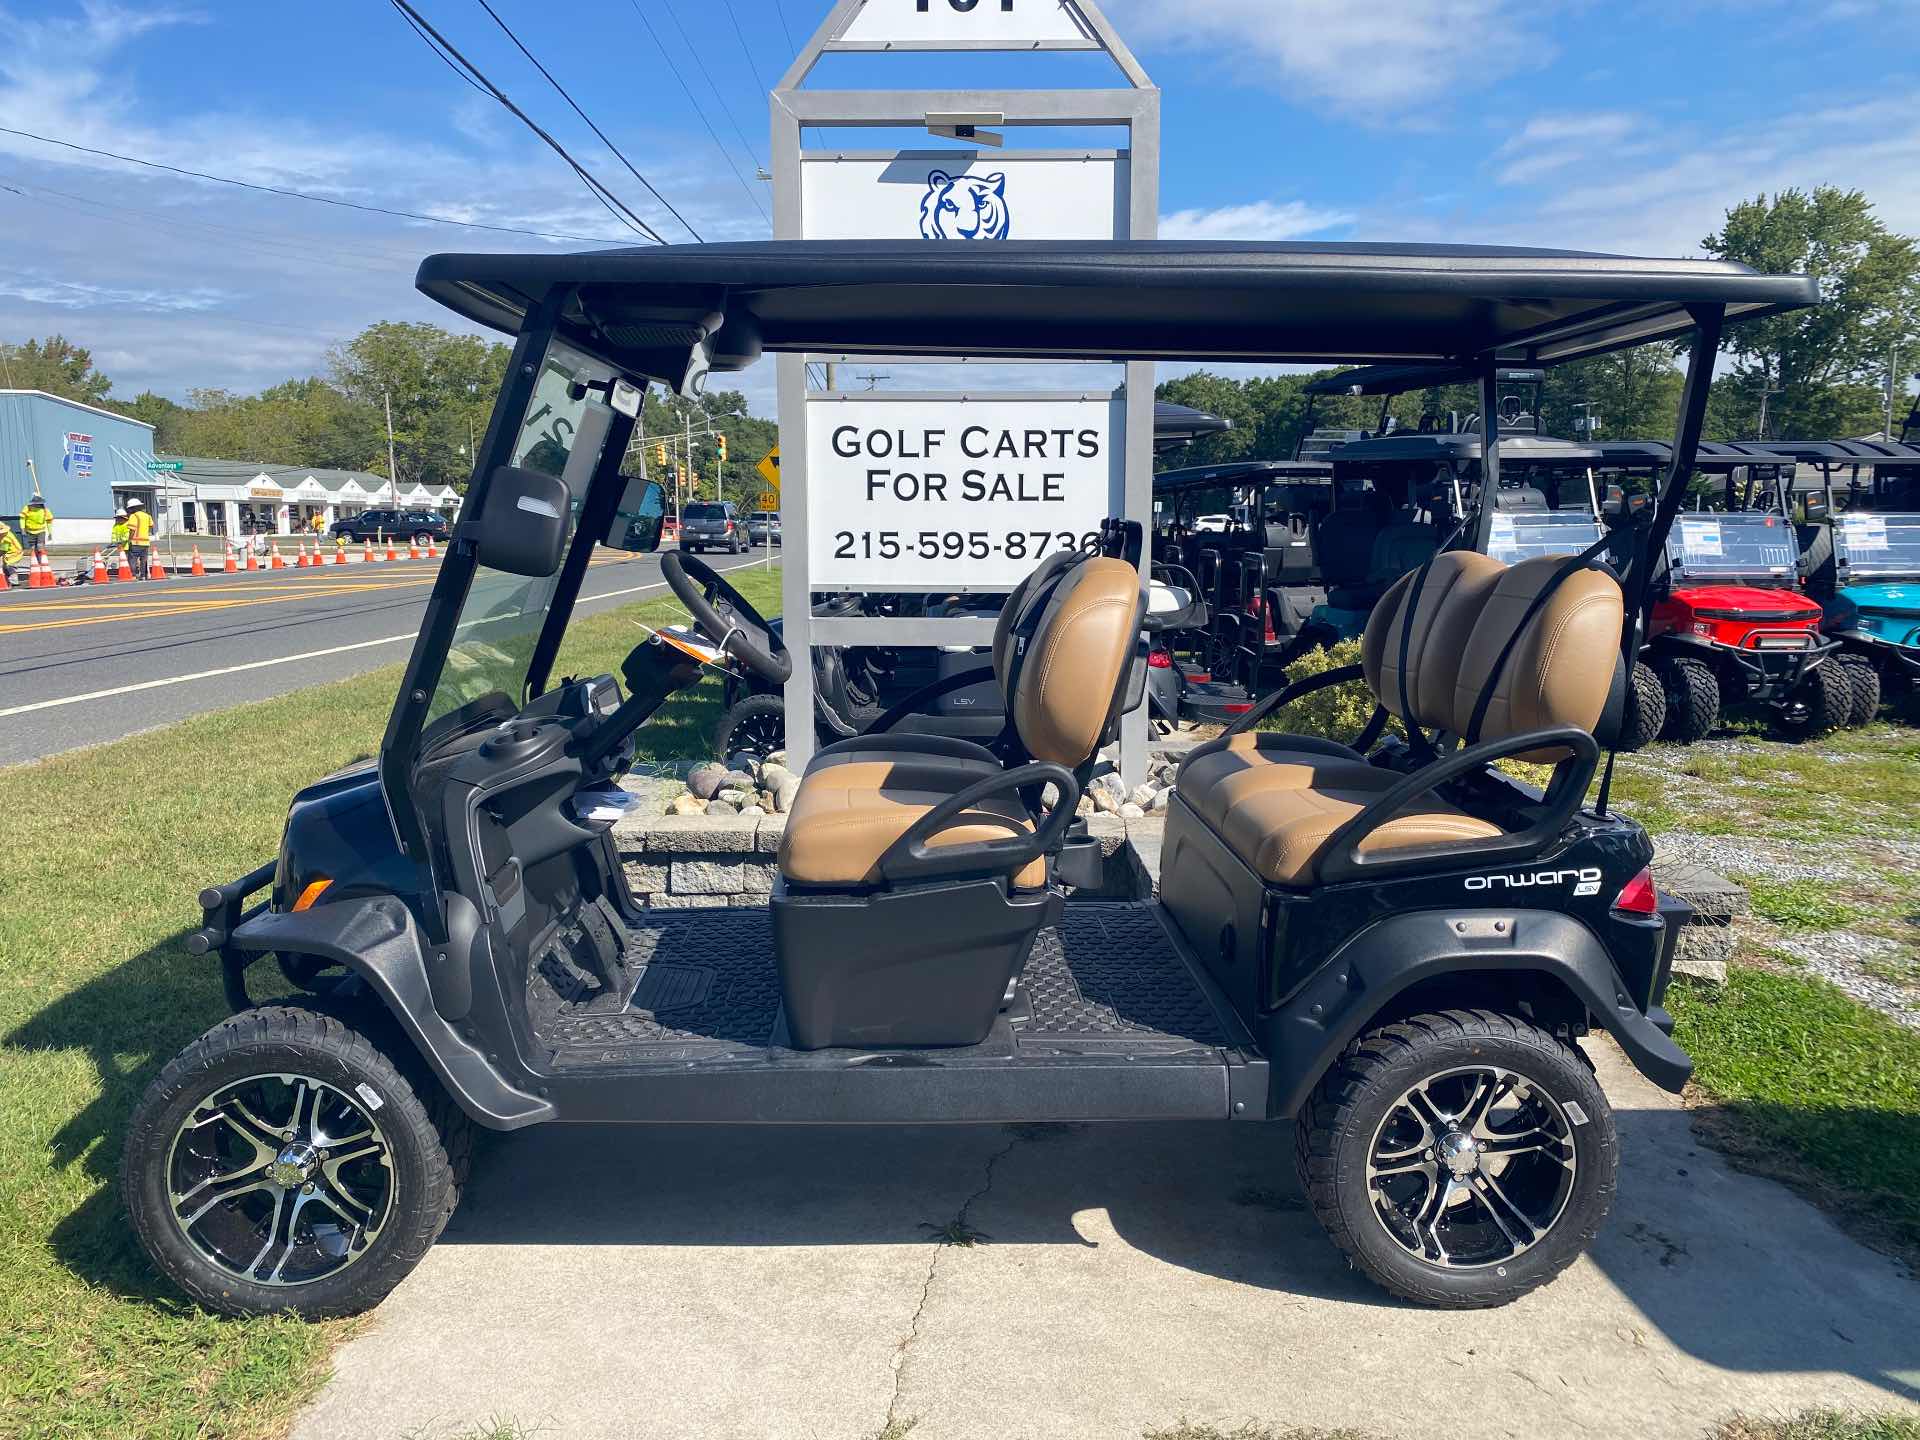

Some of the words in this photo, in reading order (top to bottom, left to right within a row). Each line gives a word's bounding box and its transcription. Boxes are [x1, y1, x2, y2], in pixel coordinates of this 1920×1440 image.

[831, 425, 946, 459] GOLF
[960, 425, 1100, 459] CARTS
[147, 462, 178, 471] Advantage
[866, 468, 948, 502] FOR
[961, 469, 1065, 502] SALE
[761, 494, 775, 504] 40
[834, 530, 1102, 560] 215-595-8736
[1577, 884, 1599, 893] LSV
